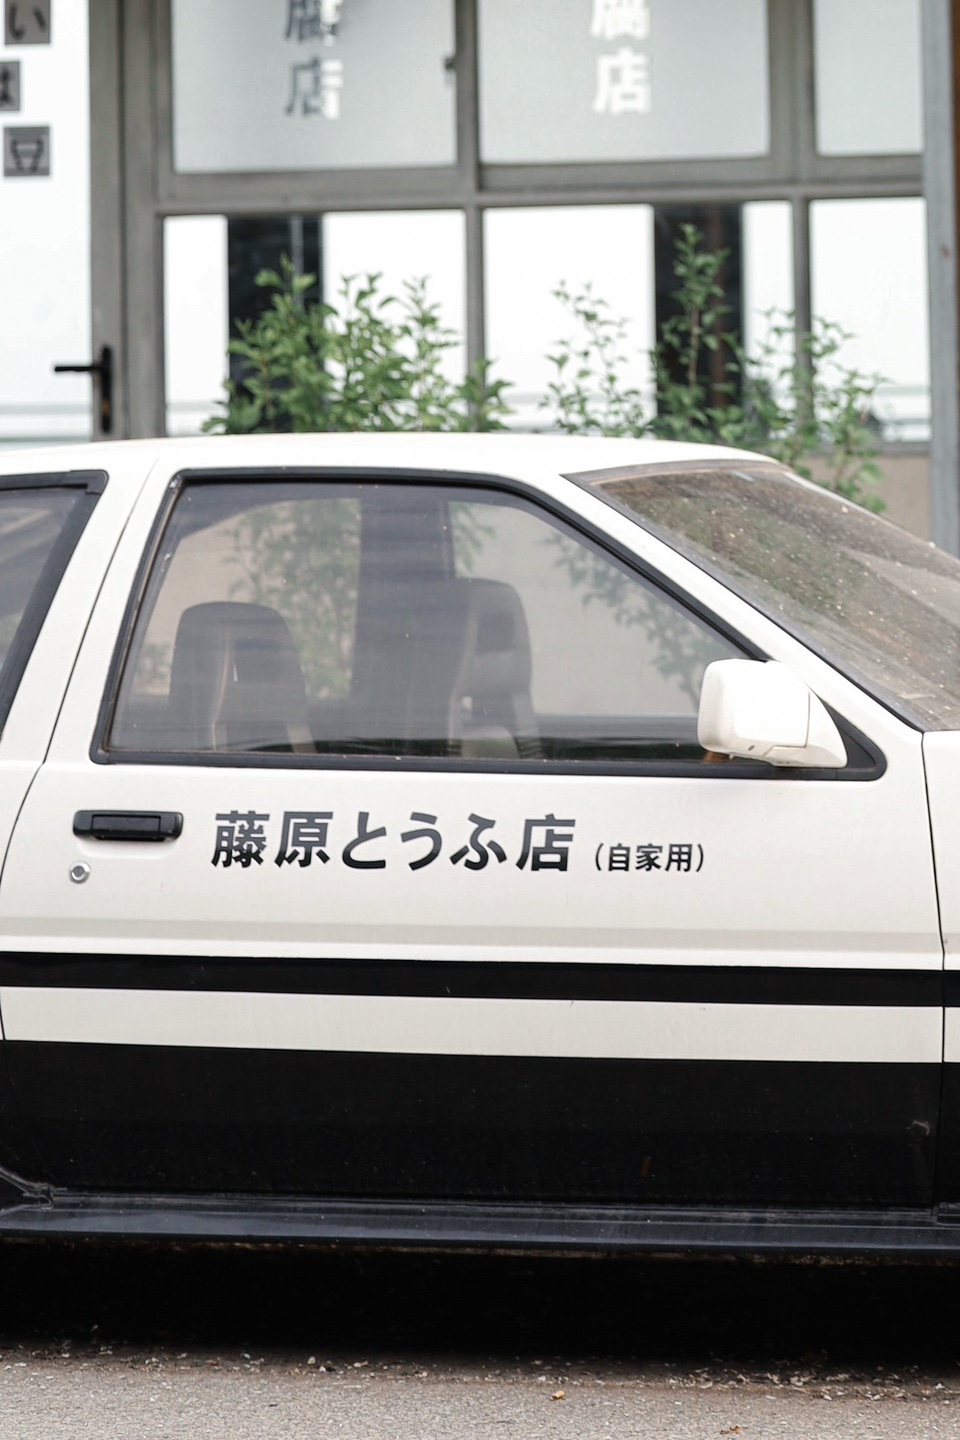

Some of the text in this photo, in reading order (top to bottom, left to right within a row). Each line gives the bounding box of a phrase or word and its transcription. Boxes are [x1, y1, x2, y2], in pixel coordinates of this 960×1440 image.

[210, 810, 577, 872] 藤原とうふ店
